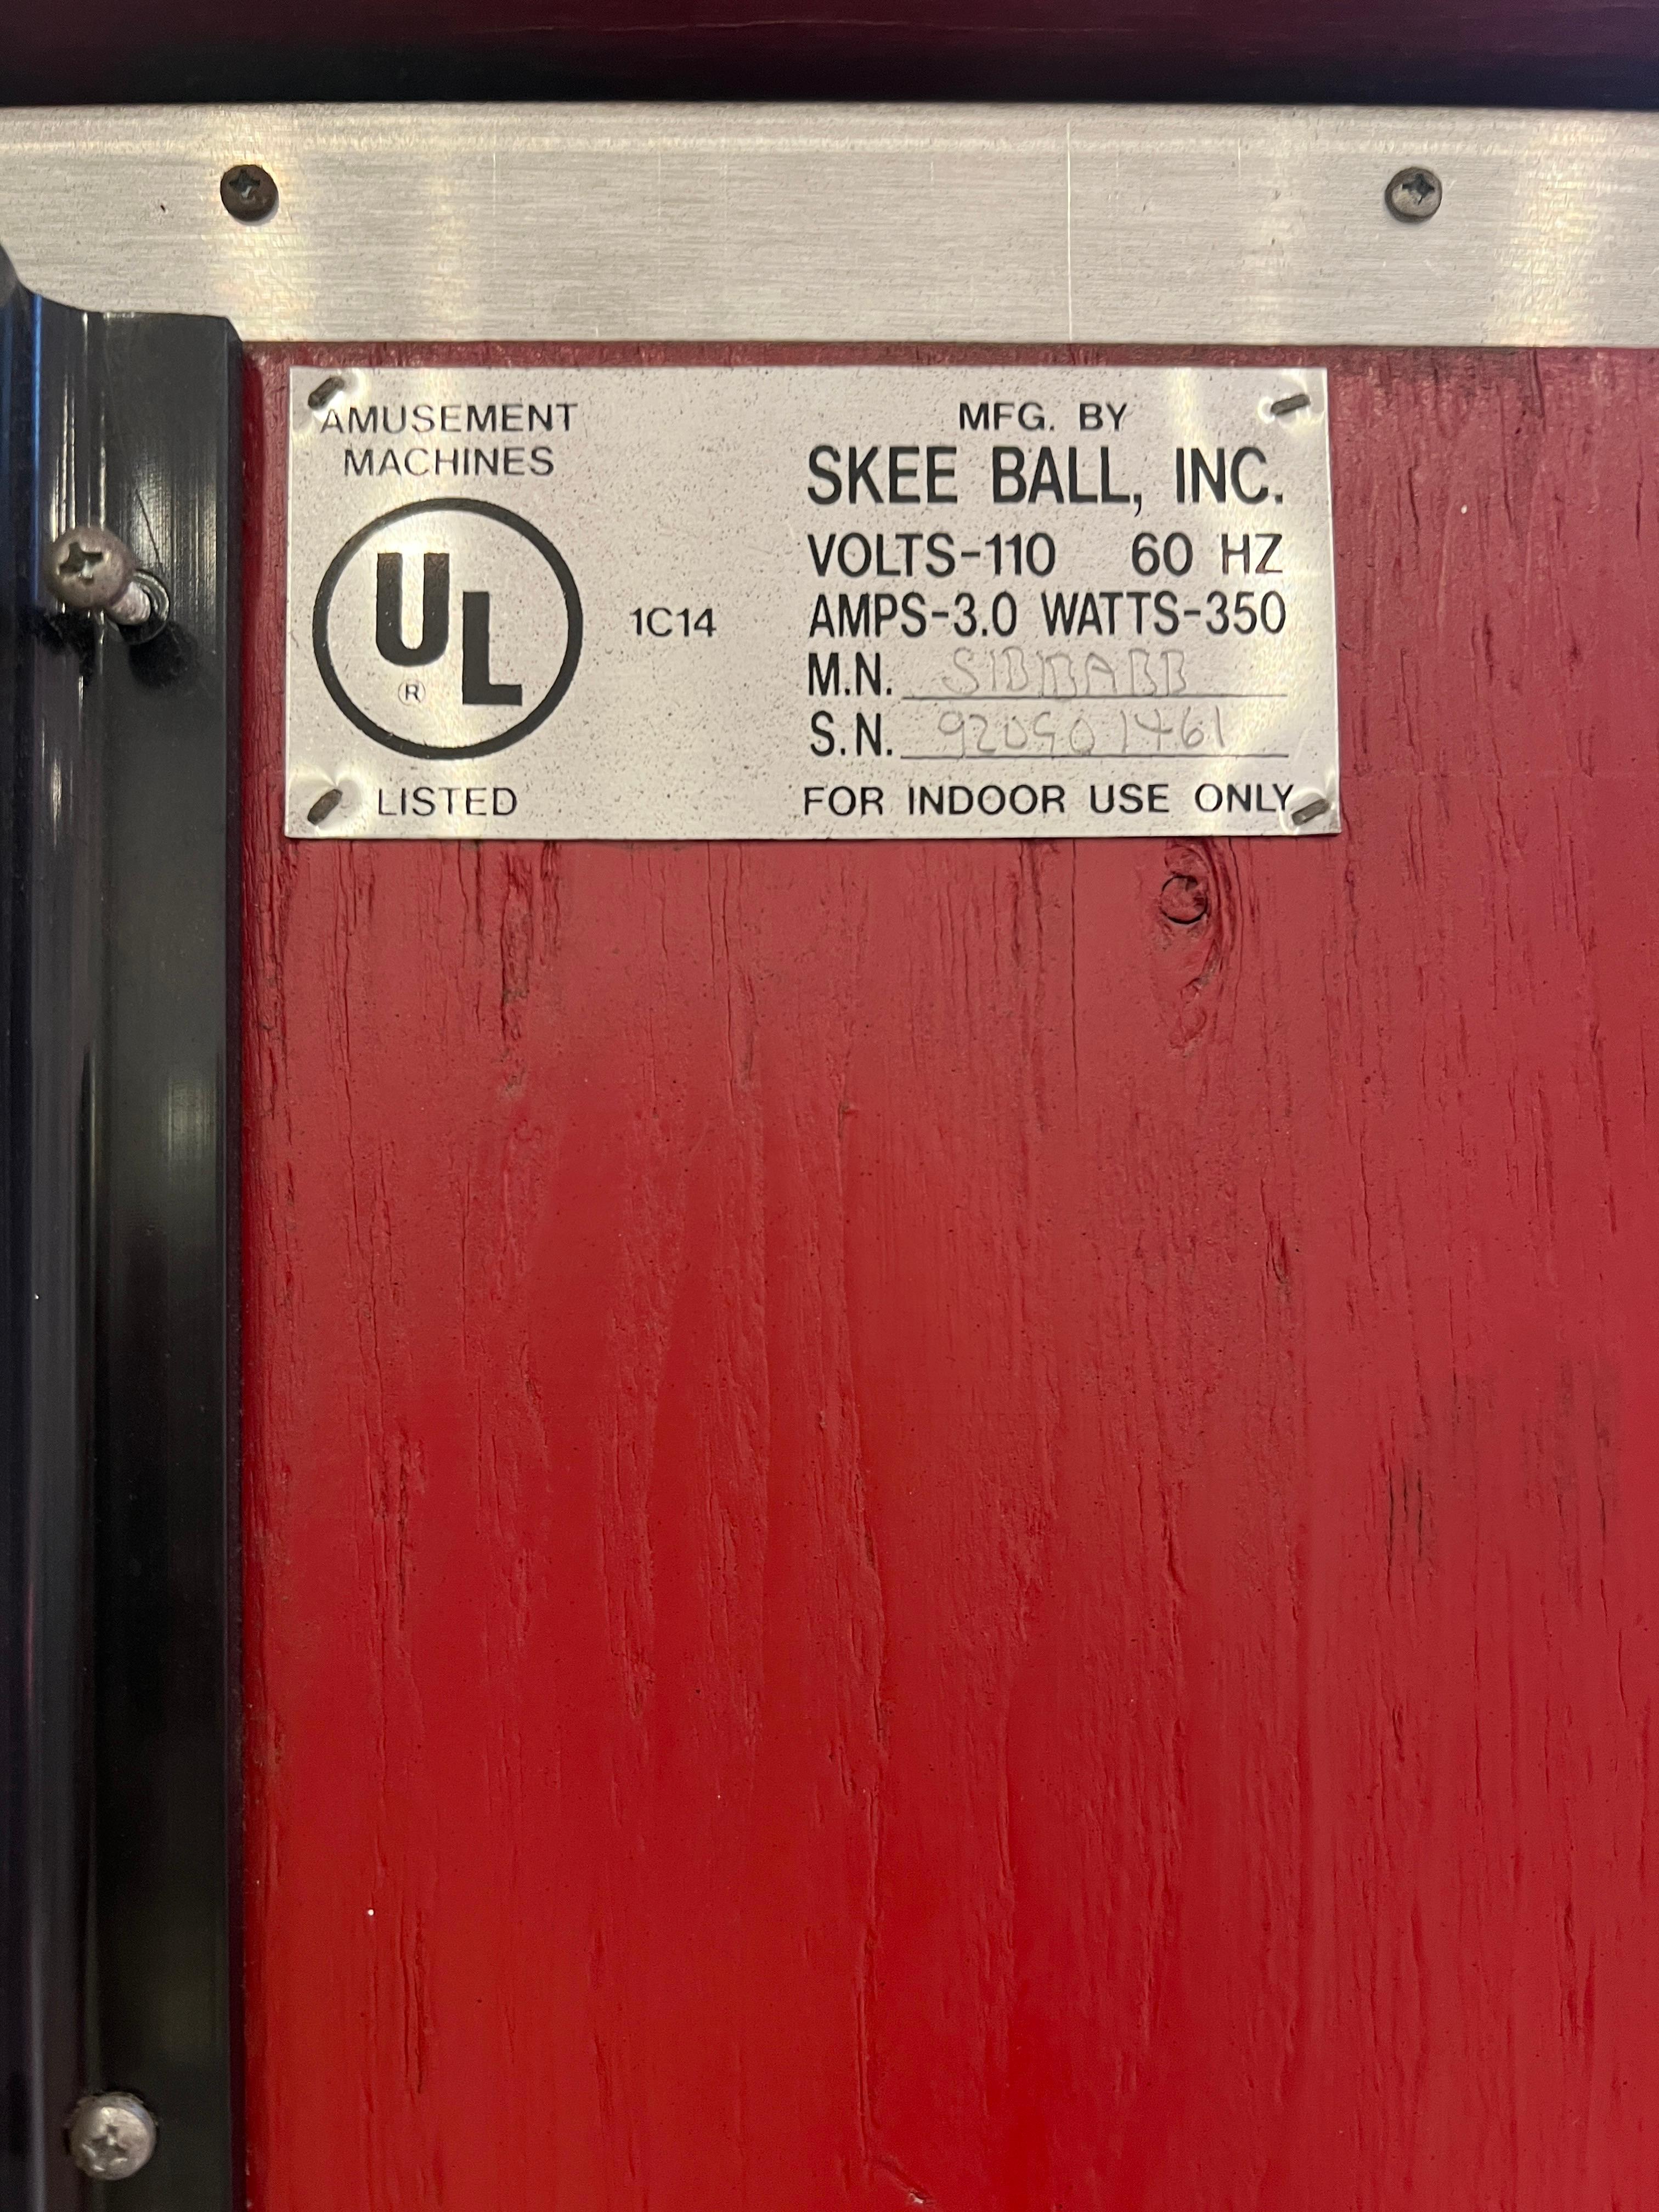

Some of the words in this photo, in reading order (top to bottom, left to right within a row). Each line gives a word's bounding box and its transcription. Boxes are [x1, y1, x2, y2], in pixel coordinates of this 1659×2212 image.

[321, 403, 578, 433] AMUSEMENT
[960, 402, 1054, 431] MFG.
[1080, 403, 1127, 431] BY
[343, 446, 554, 476] MACHINES
[808, 445, 958, 505] SKEE
[992, 445, 1142, 517] BALL,
[1176, 445, 1284, 505] INC.
[808, 532, 1056, 578] VOLTS-110
[1132, 532, 1193, 577] 60
[1221, 533, 1283, 575] HZ
[376, 552, 522, 706] UL
[630, 607, 717, 637] 1C14
[809, 590, 1017, 637] AMPS-3.0
[1040, 590, 1286, 636] WATTS-350
[808, 651, 892, 696] M.N.
[810, 710, 893, 757] S.N.
[378, 787, 518, 816] LISTED
[804, 785, 884, 816] FOR
[909, 784, 1065, 816] INDOOR
[1090, 783, 1170, 814] USE
[1194, 783, 1294, 812] ONLY
